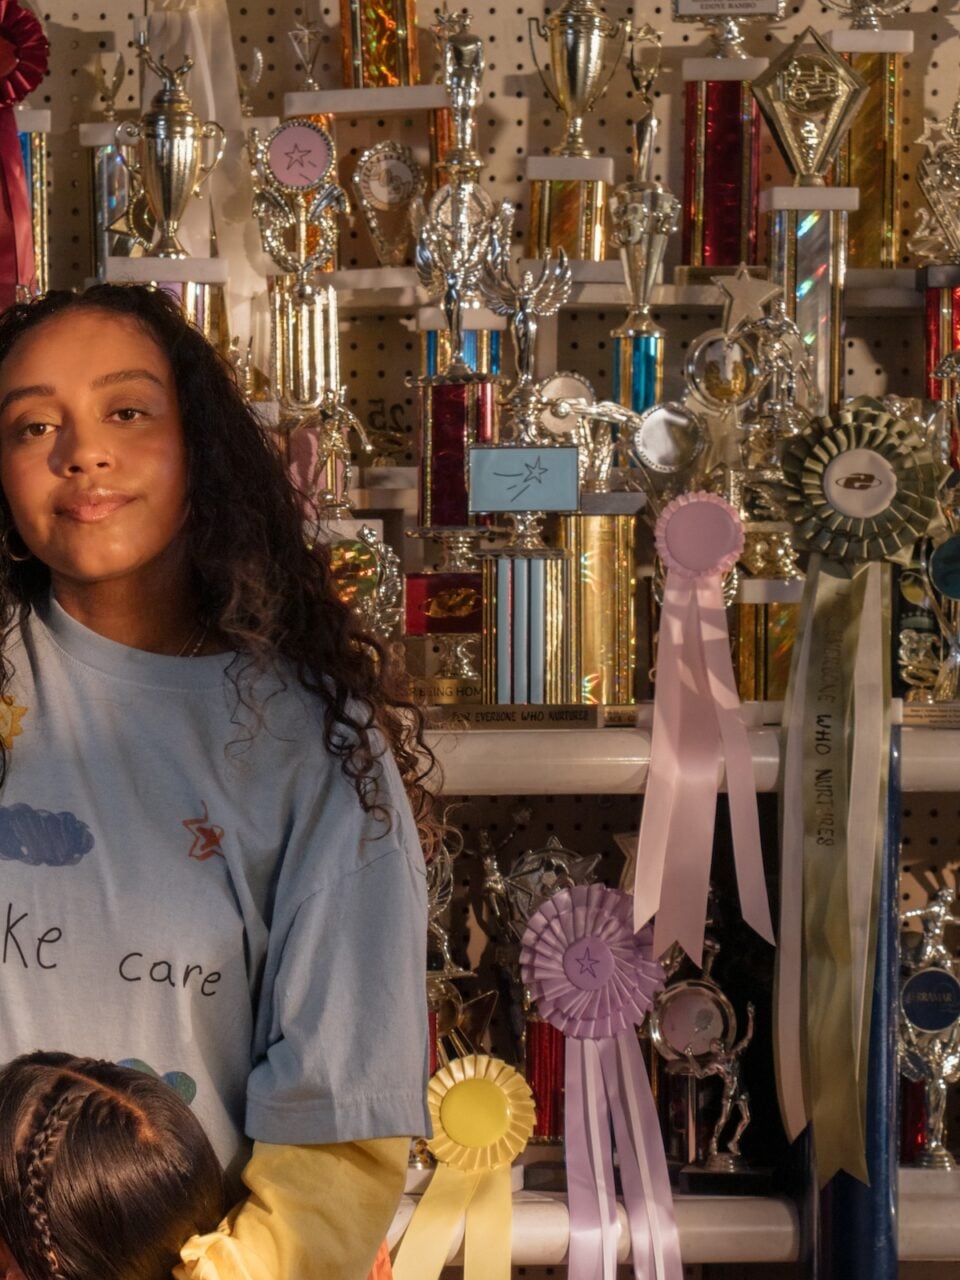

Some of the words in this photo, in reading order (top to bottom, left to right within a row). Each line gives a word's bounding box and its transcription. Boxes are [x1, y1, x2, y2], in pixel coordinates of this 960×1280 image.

[520, 710, 544, 722] WHO
[815, 714, 832, 755] WHO
[118, 951, 222, 997] care
